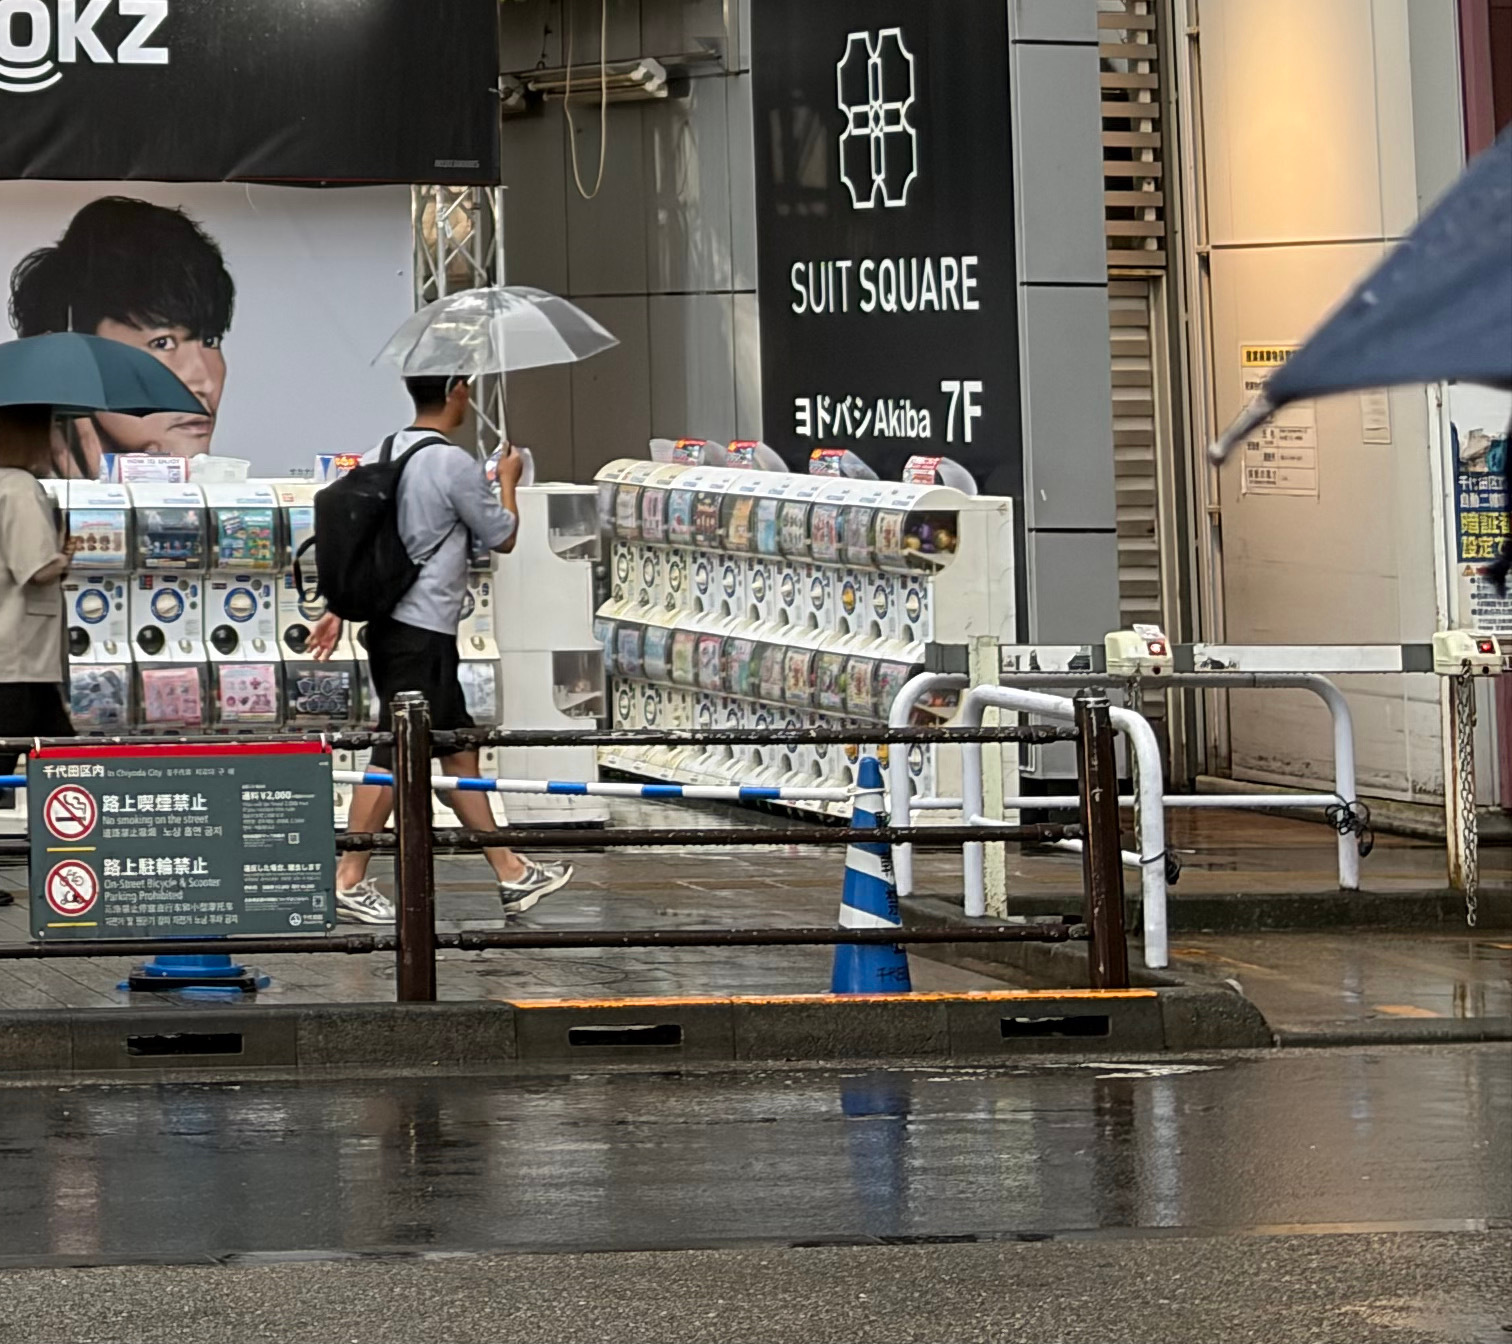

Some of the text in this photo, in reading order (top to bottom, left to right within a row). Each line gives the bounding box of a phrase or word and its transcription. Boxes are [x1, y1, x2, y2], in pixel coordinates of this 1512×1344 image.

[791, 255, 980, 314] SUIT SQUARE
[794, 380, 983, 443] ヨドバシAkiba 7F
[42, 764, 105, 779] 千代田区内
[101, 792, 208, 813] 路上喫煙禁止
[103, 856, 209, 876] 路上駐輪禁止
